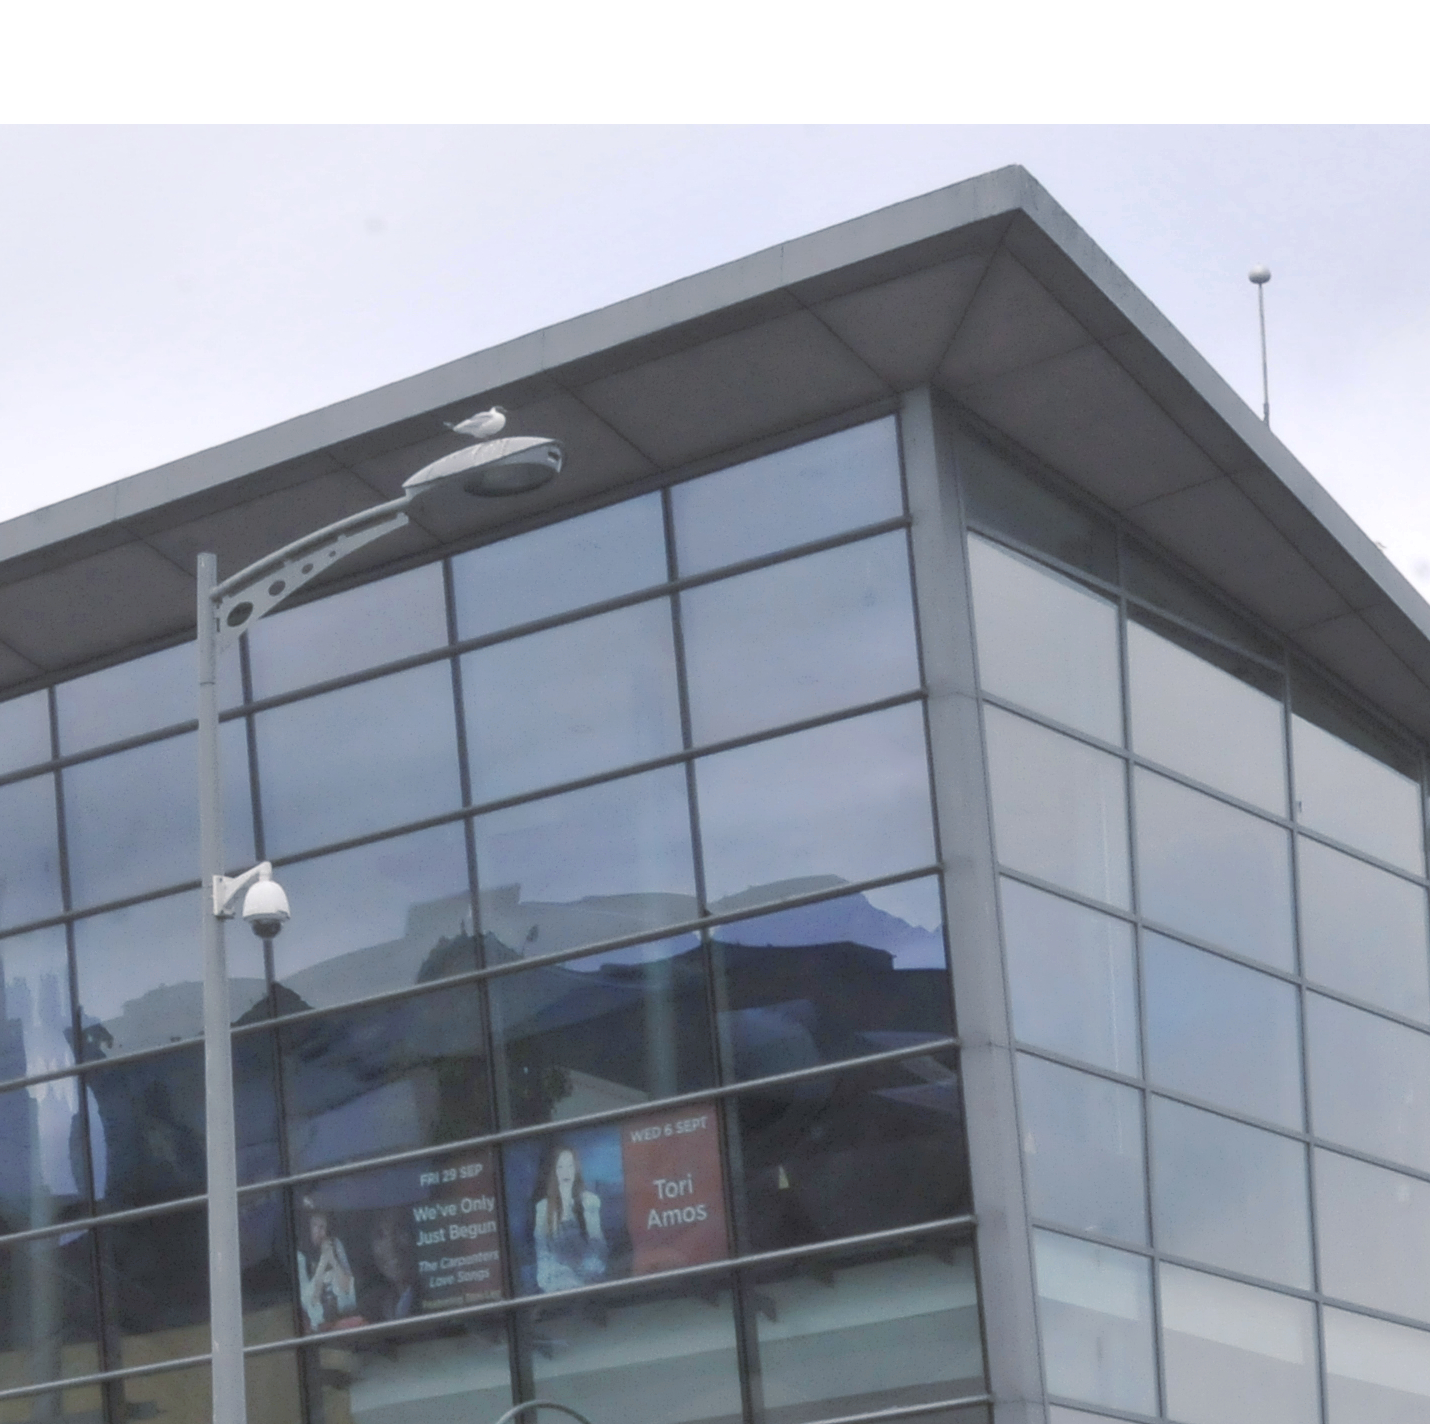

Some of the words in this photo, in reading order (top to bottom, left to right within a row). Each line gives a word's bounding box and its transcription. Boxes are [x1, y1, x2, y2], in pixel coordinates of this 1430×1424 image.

[631, 1126, 661, 1143] WED
[664, 1123, 672, 1136] 6
[675, 1115, 708, 1134] SEPT
[420, 1171, 439, 1187] FRI
[442, 1168, 457, 1182] 29
[459, 1163, 483, 1179] SEP
[653, 1172, 693, 1199] Tori
[413, 1203, 457, 1222] We've
[460, 1194, 495, 1213] Only
[647, 1204, 708, 1230] Amos
[416, 1228, 446, 1246] Just
[448, 1221, 497, 1240] Begun
[418, 1260, 438, 1272] The
[439, 1249, 500, 1269] Carpenters
[457, 1268, 490, 1283] Songs
